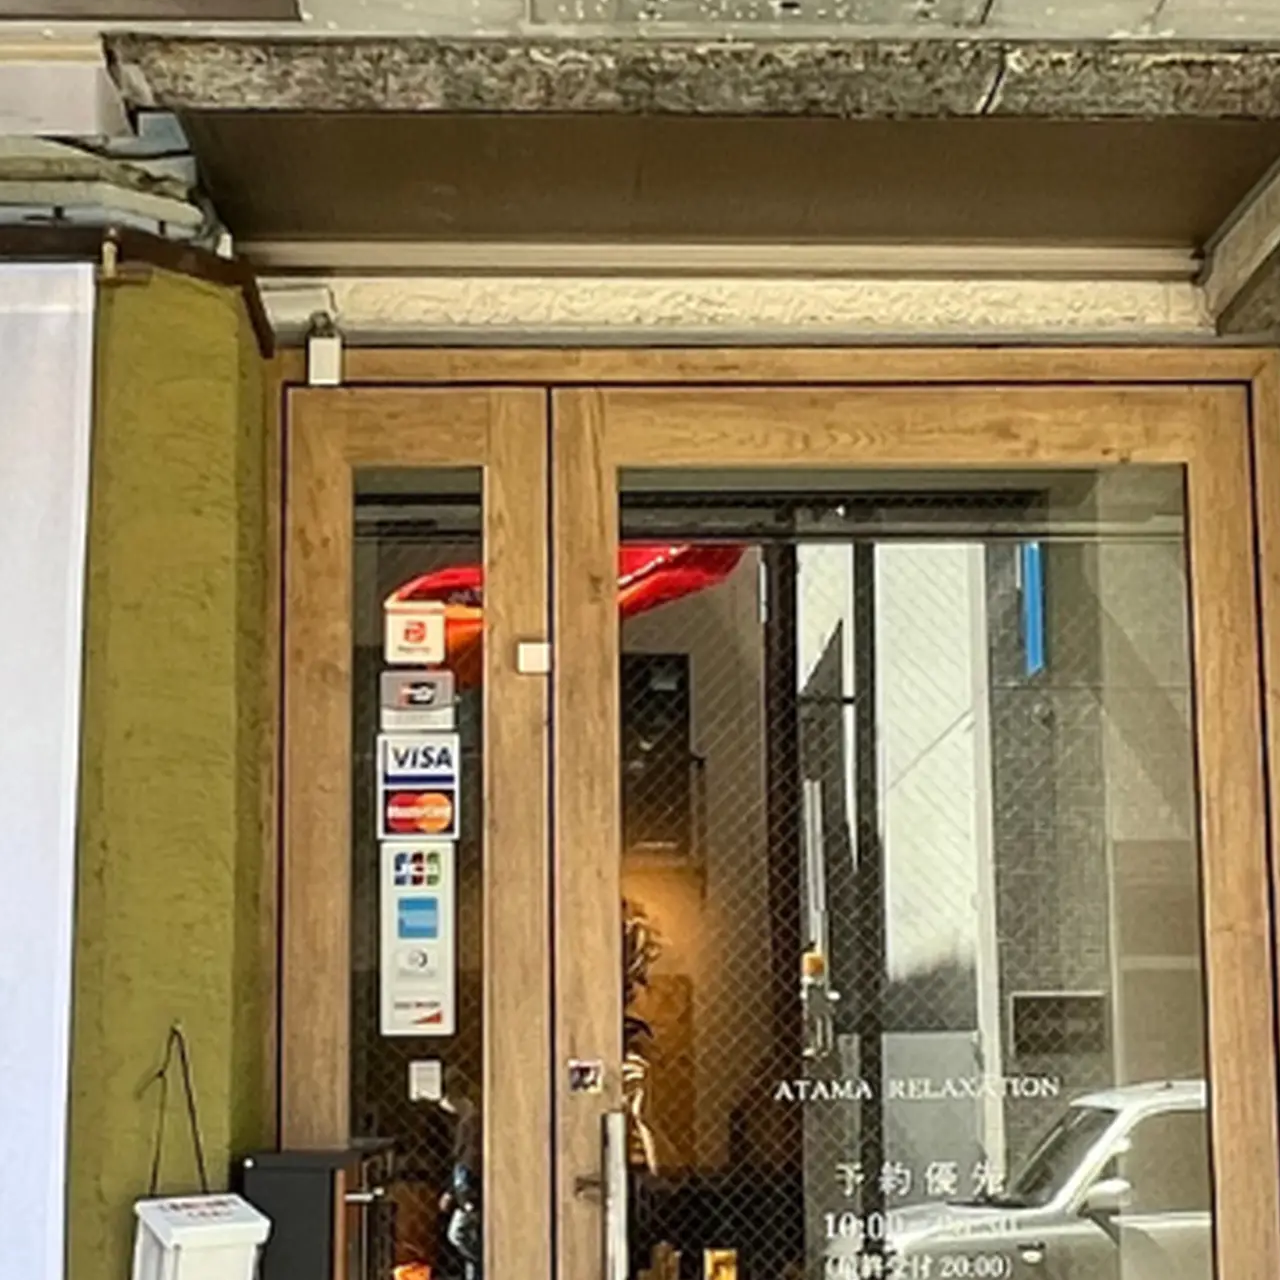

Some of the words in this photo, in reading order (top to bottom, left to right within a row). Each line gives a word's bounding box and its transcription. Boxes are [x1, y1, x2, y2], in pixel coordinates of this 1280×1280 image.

[392, 746, 453, 770] VISA
[774, 1079, 873, 1101] ATAMA
[886, 1076, 1060, 1099] RELAXATION
